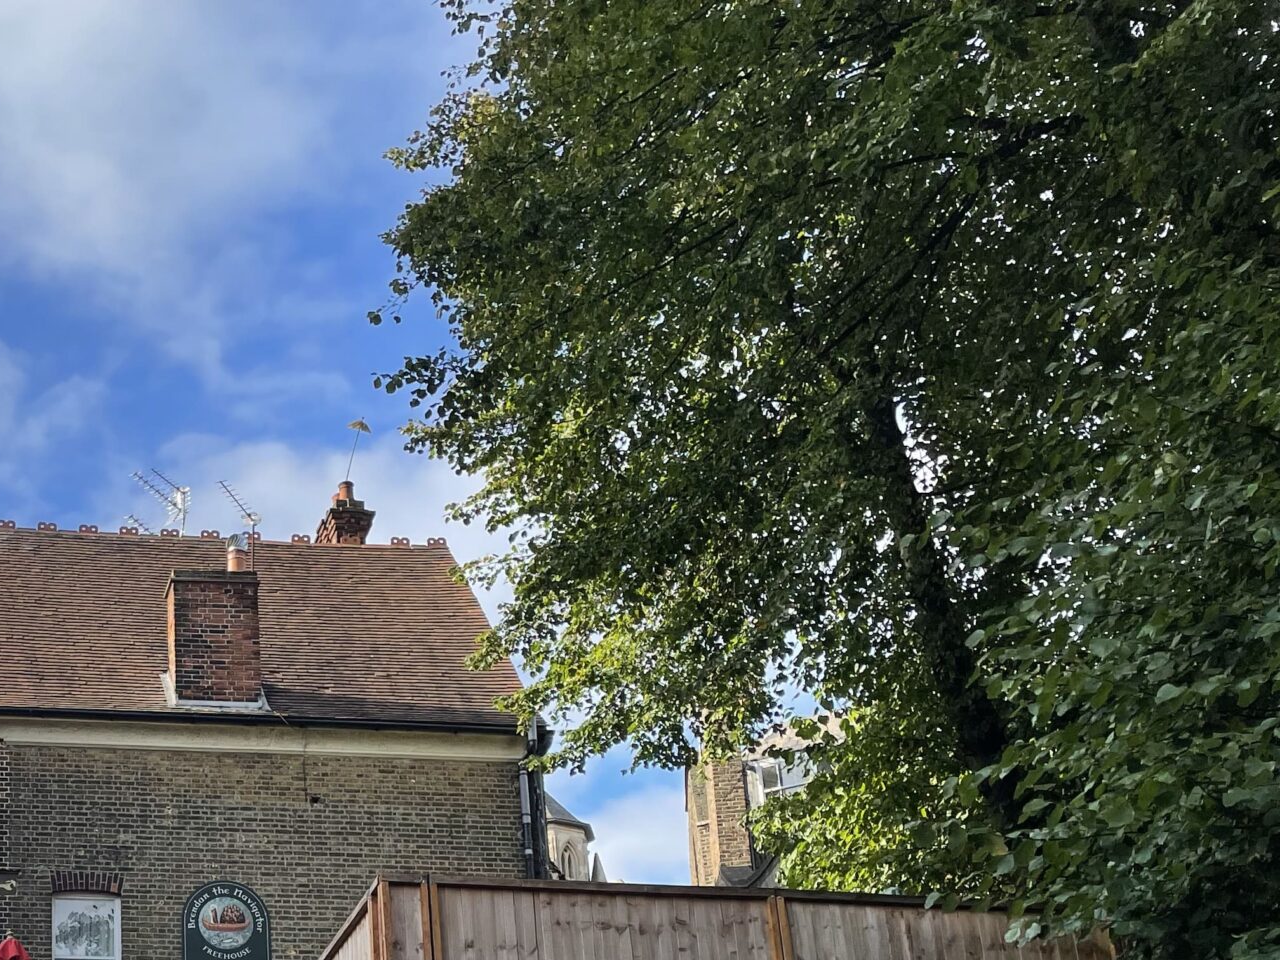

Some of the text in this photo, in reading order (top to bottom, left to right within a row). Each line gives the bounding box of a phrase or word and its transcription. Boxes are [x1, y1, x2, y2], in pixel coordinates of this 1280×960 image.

[187, 886, 264, 934] Brendan the Navigator
[202, 945, 252, 960] FREEHOUSE
